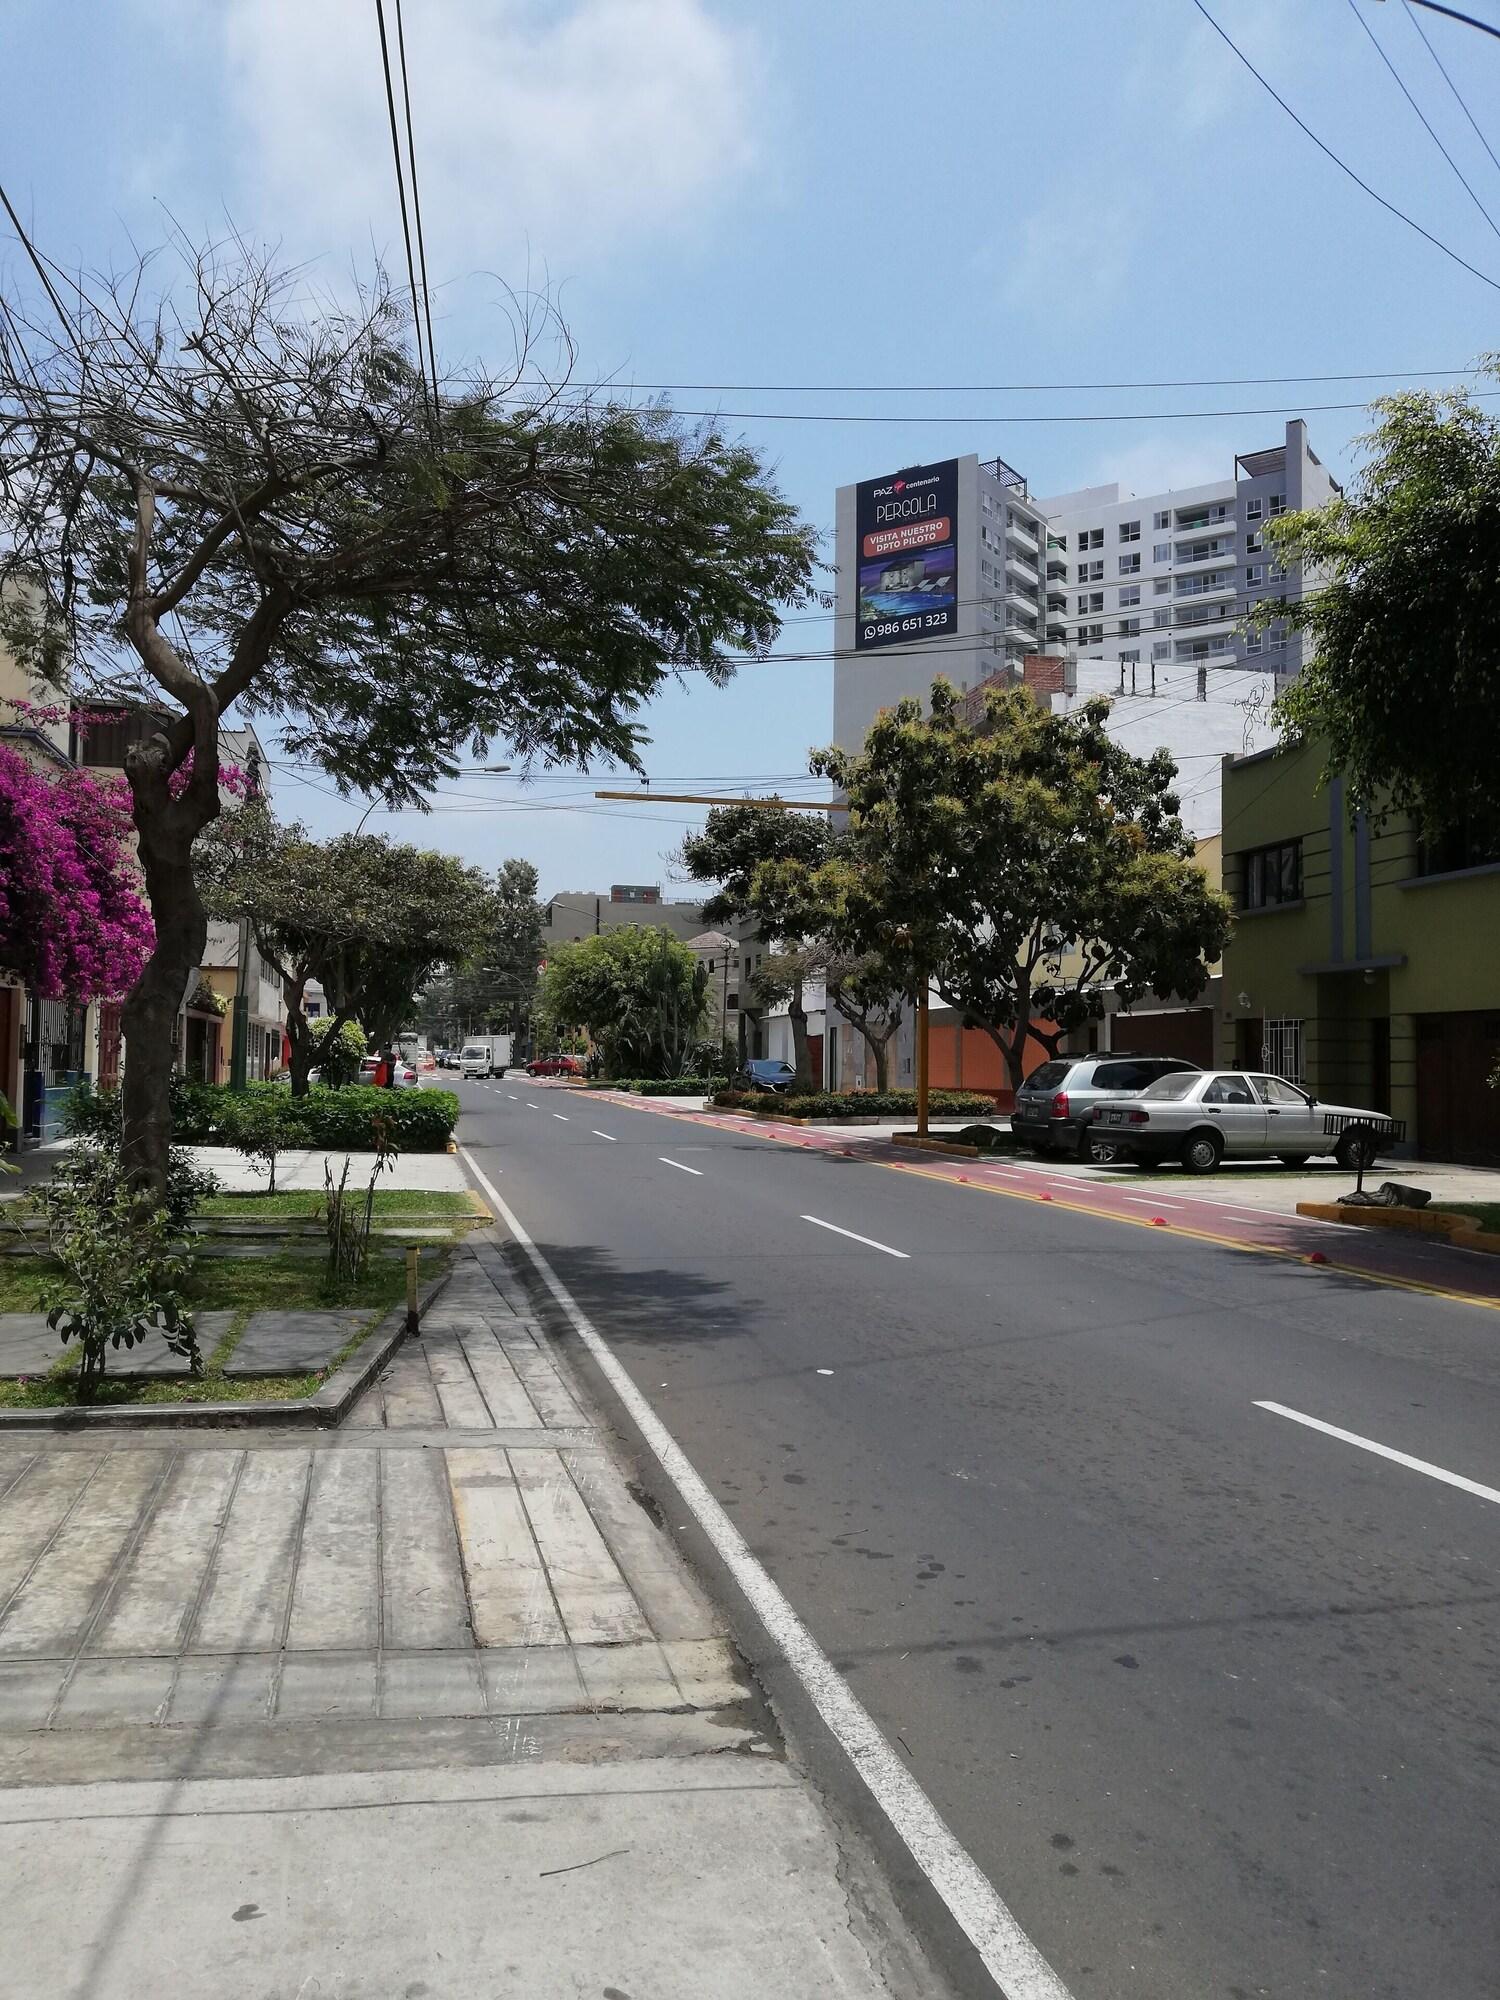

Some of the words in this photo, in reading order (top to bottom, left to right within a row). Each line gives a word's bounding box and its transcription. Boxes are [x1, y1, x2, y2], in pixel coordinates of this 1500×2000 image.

[873, 486, 893, 498] PAZ
[905, 475, 940, 489] centenario
[876, 493, 937, 523] PERGOLA
[870, 532, 898, 545] VISITA
[900, 521, 943, 538] NUESTRO
[876, 540, 901, 552] DPTO
[903, 533, 936, 546] PILOTO
[877, 622, 899, 636] 986
[902, 617, 922, 631] 651
[925, 612, 948, 627] 323
